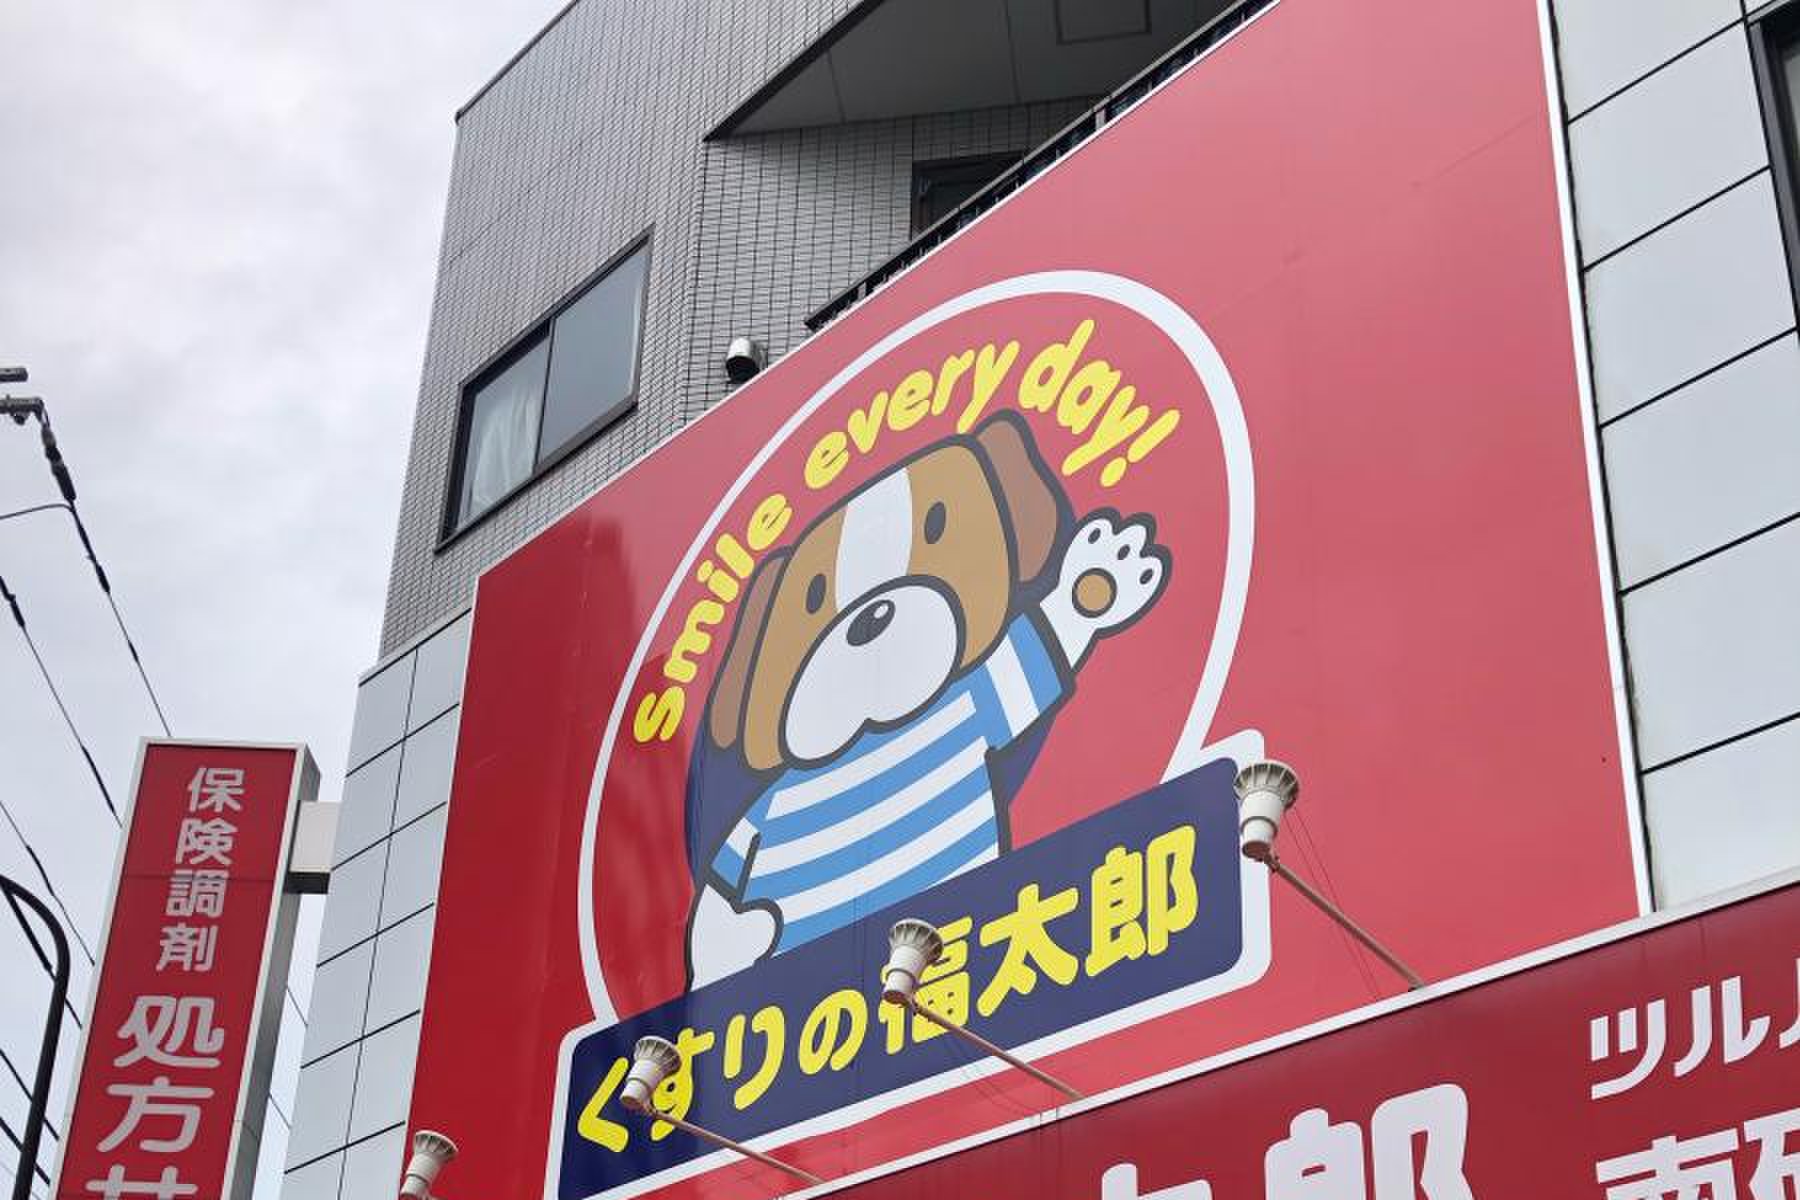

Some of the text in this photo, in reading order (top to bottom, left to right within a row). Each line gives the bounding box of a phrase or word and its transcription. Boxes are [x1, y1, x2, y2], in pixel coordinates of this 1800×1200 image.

[804, 340, 1020, 489] every
[1018, 319, 1180, 488] day!
[157, 766, 244, 972] 保険調剤
[577, 825, 1199, 1153] くすりの福太郎
[1590, 974, 1800, 1100] ツル
